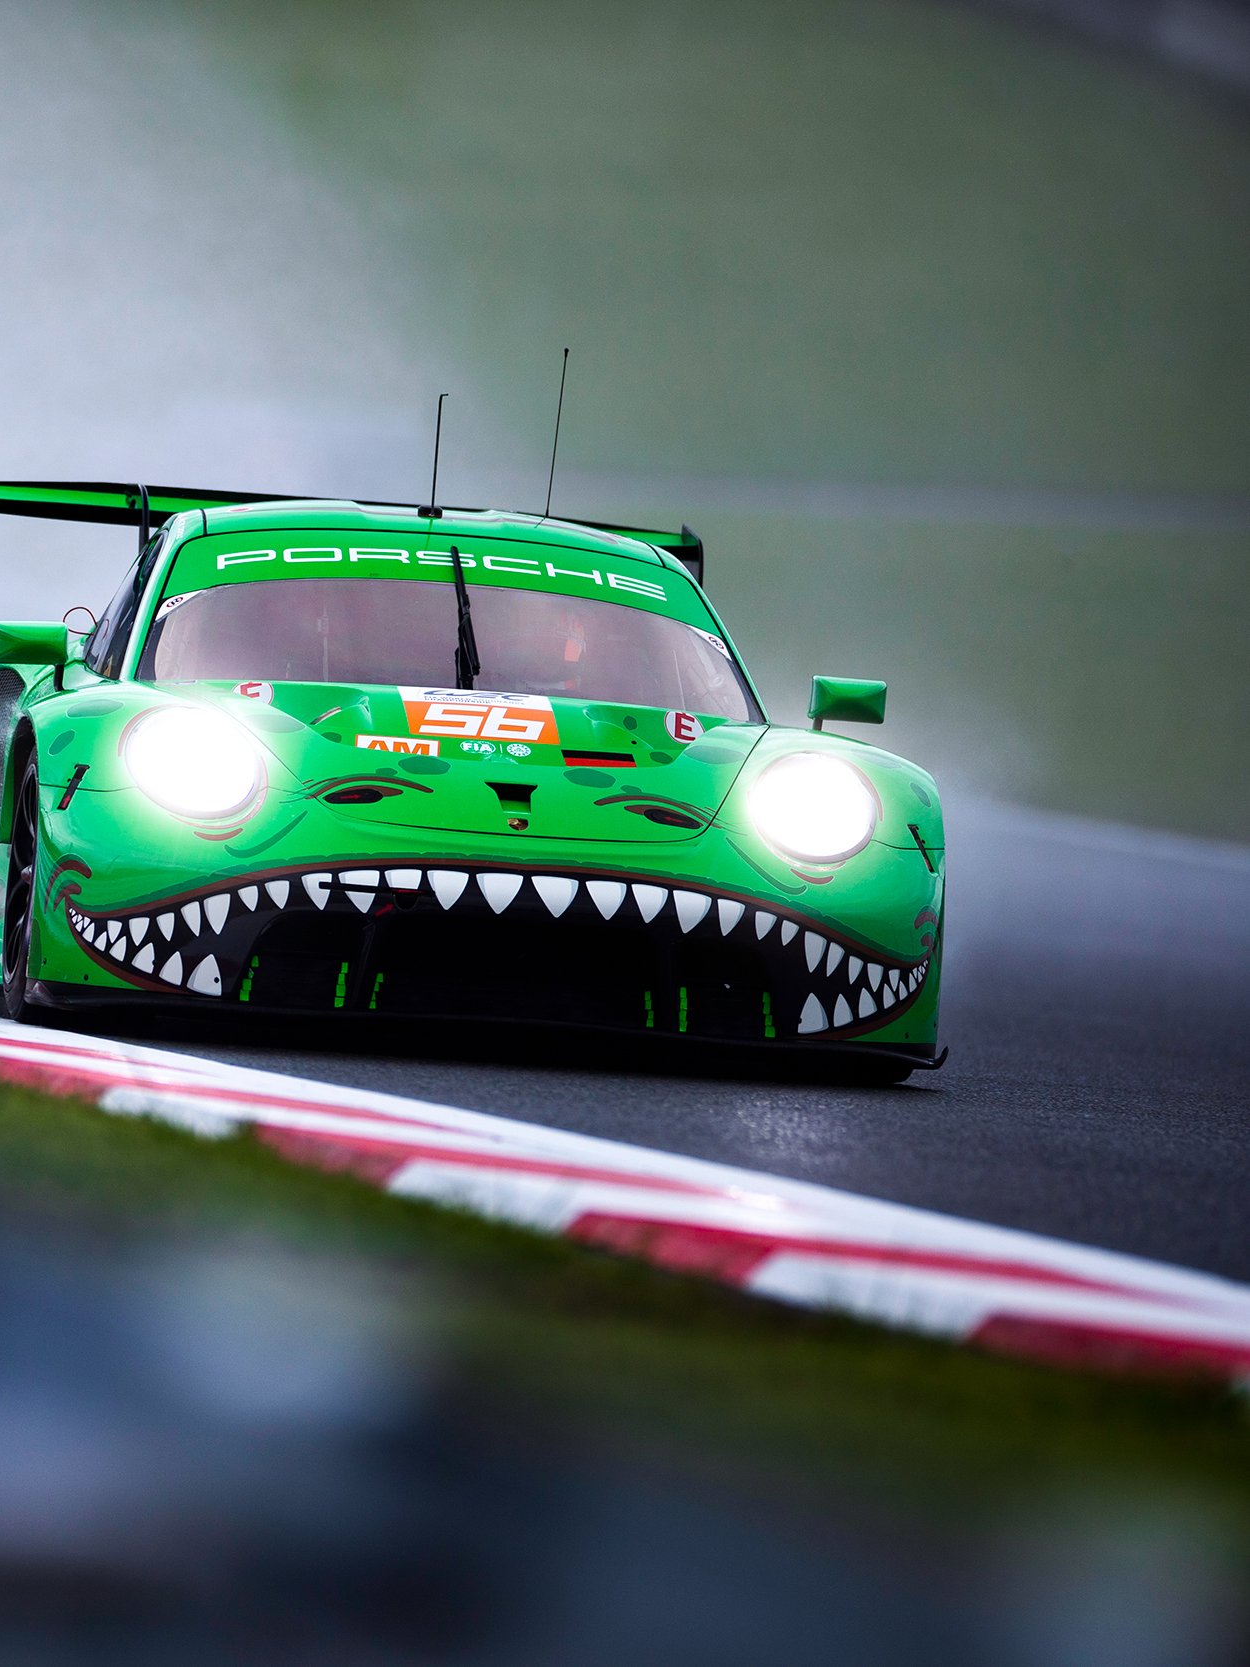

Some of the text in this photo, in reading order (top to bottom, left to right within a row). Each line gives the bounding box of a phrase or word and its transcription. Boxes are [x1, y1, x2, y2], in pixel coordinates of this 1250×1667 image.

[217, 547, 668, 602] PORSCHE
[418, 703, 546, 741] 56
[367, 739, 430, 757] AM
[461, 741, 494, 753] FIA
